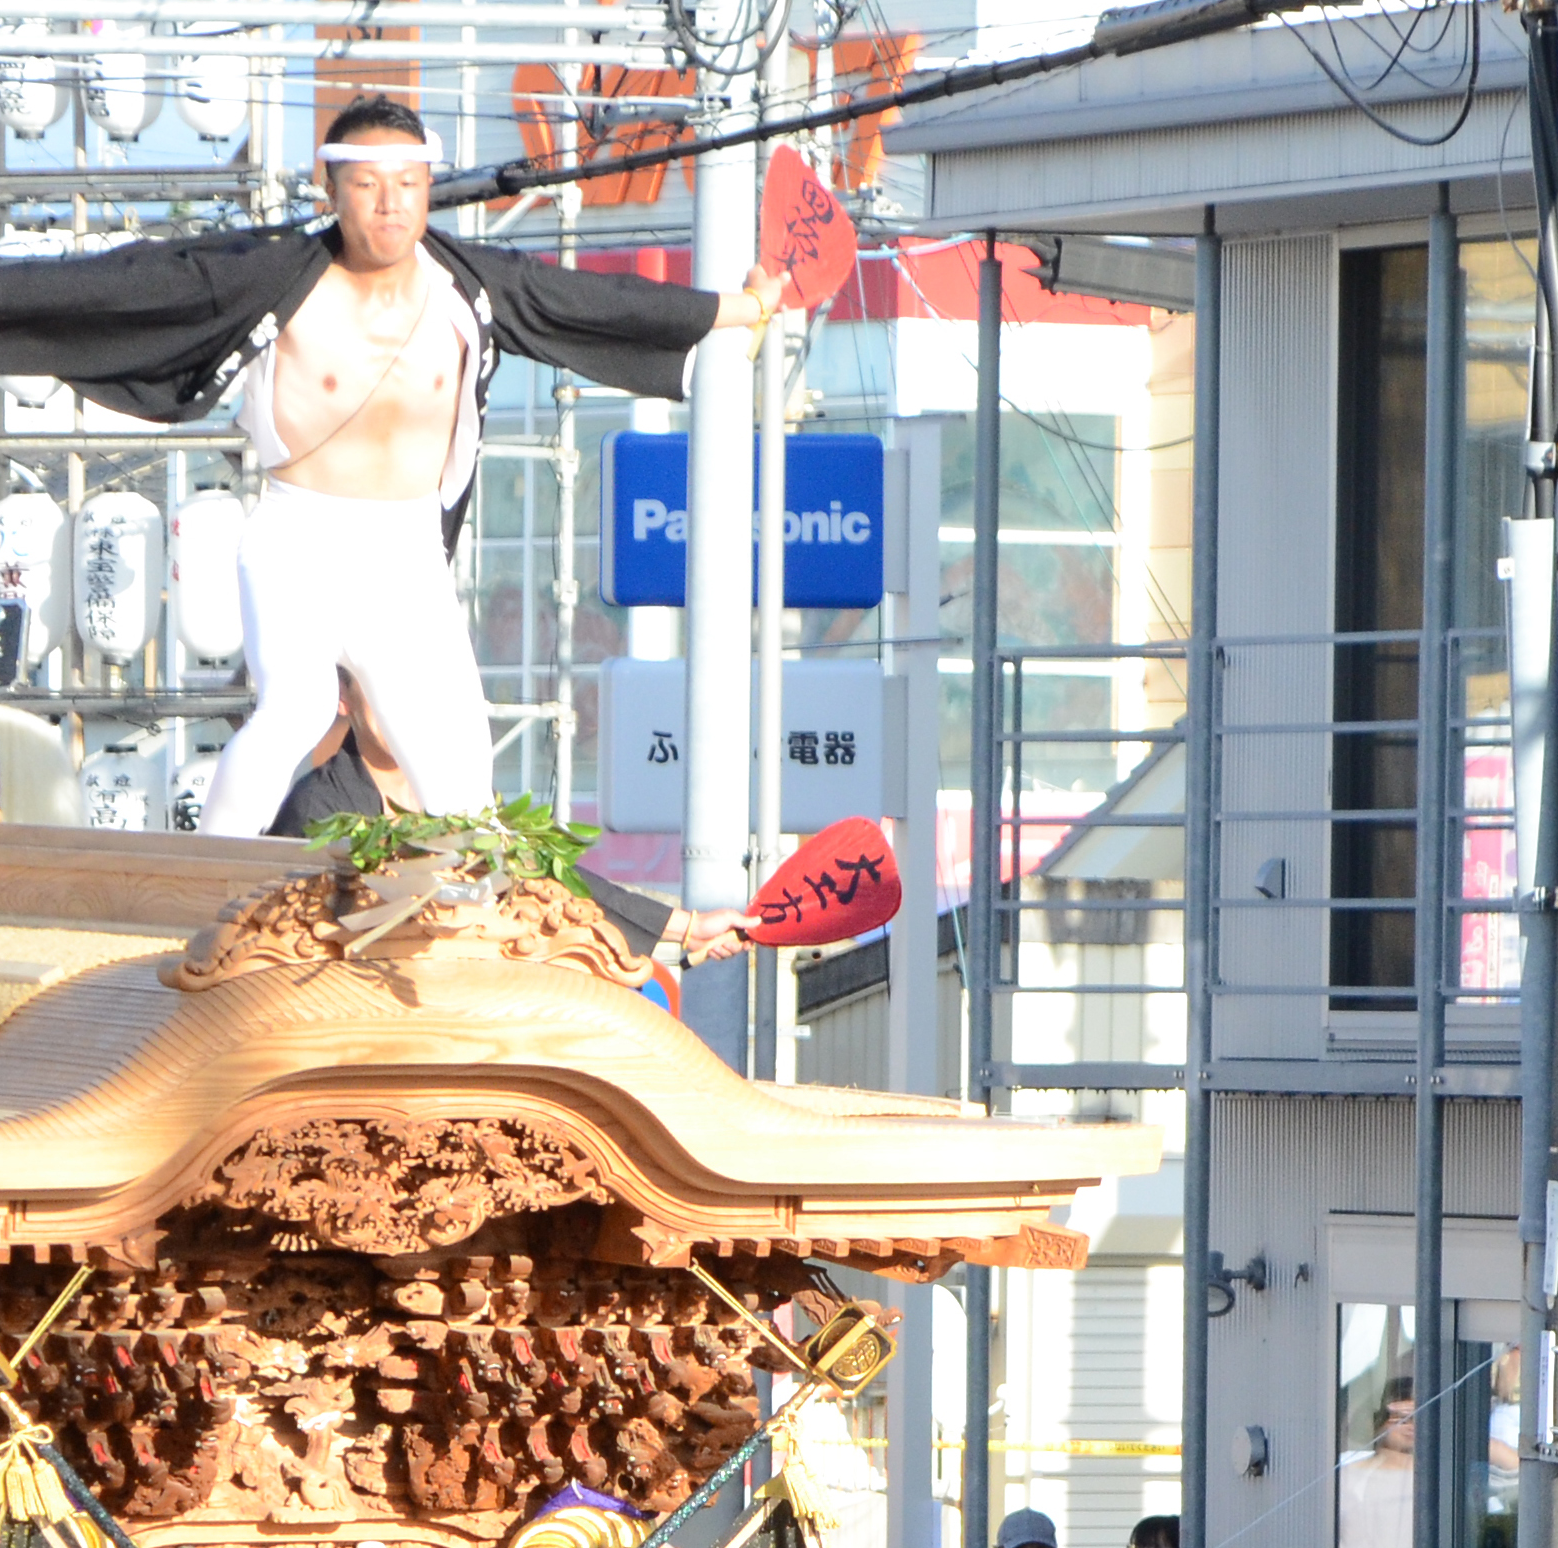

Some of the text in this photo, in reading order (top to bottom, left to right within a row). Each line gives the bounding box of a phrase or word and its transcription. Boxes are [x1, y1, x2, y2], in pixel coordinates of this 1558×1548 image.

[633, 498, 871, 543] Paonic
[647, 730, 857, 766] ふ電器
